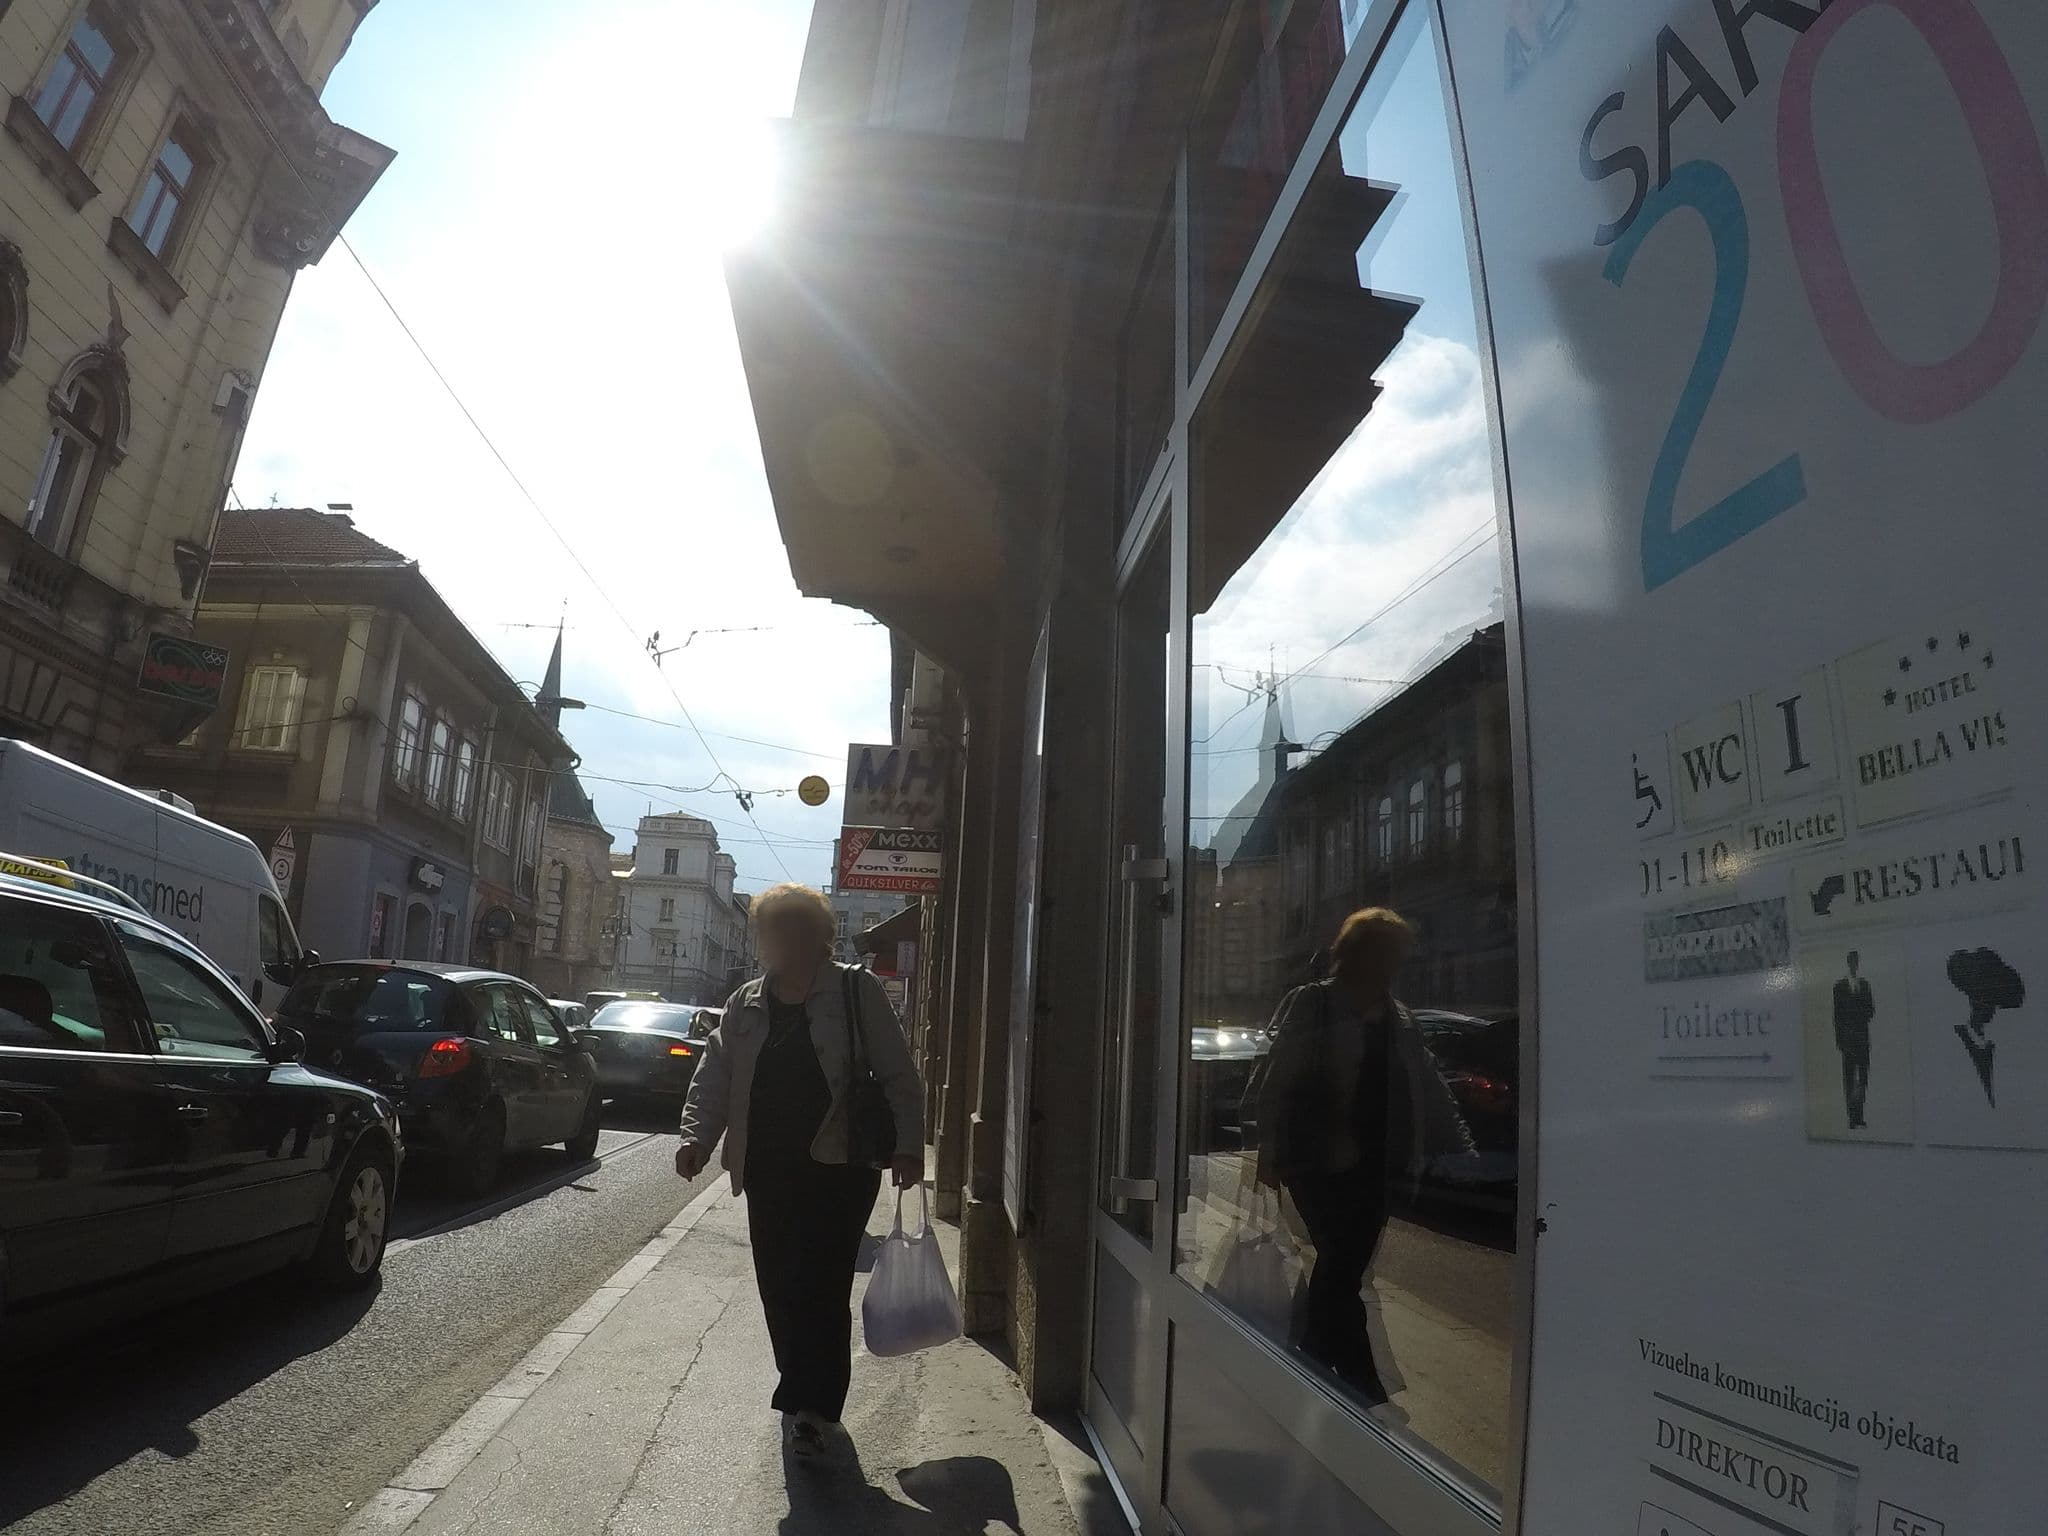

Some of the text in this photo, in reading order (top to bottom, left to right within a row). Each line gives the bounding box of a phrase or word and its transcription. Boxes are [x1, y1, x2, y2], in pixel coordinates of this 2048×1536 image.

[1904, 672, 1977, 714] HOTEL
[1776, 695, 1811, 775] I
[1857, 731, 1952, 786] BELLA
[1682, 733, 1743, 793] WC
[1750, 812, 1836, 851] Toilette
[848, 877, 920, 890] QUIKSILVER
[856, 864, 889, 872] TOM
[893, 864, 938, 874] TAILOR
[1658, 1003, 1773, 1039] Toilette
[1638, 1338, 1961, 1464] Vizuelna komunikacija objekata
[1656, 1417, 1811, 1513] DIREKTOR
